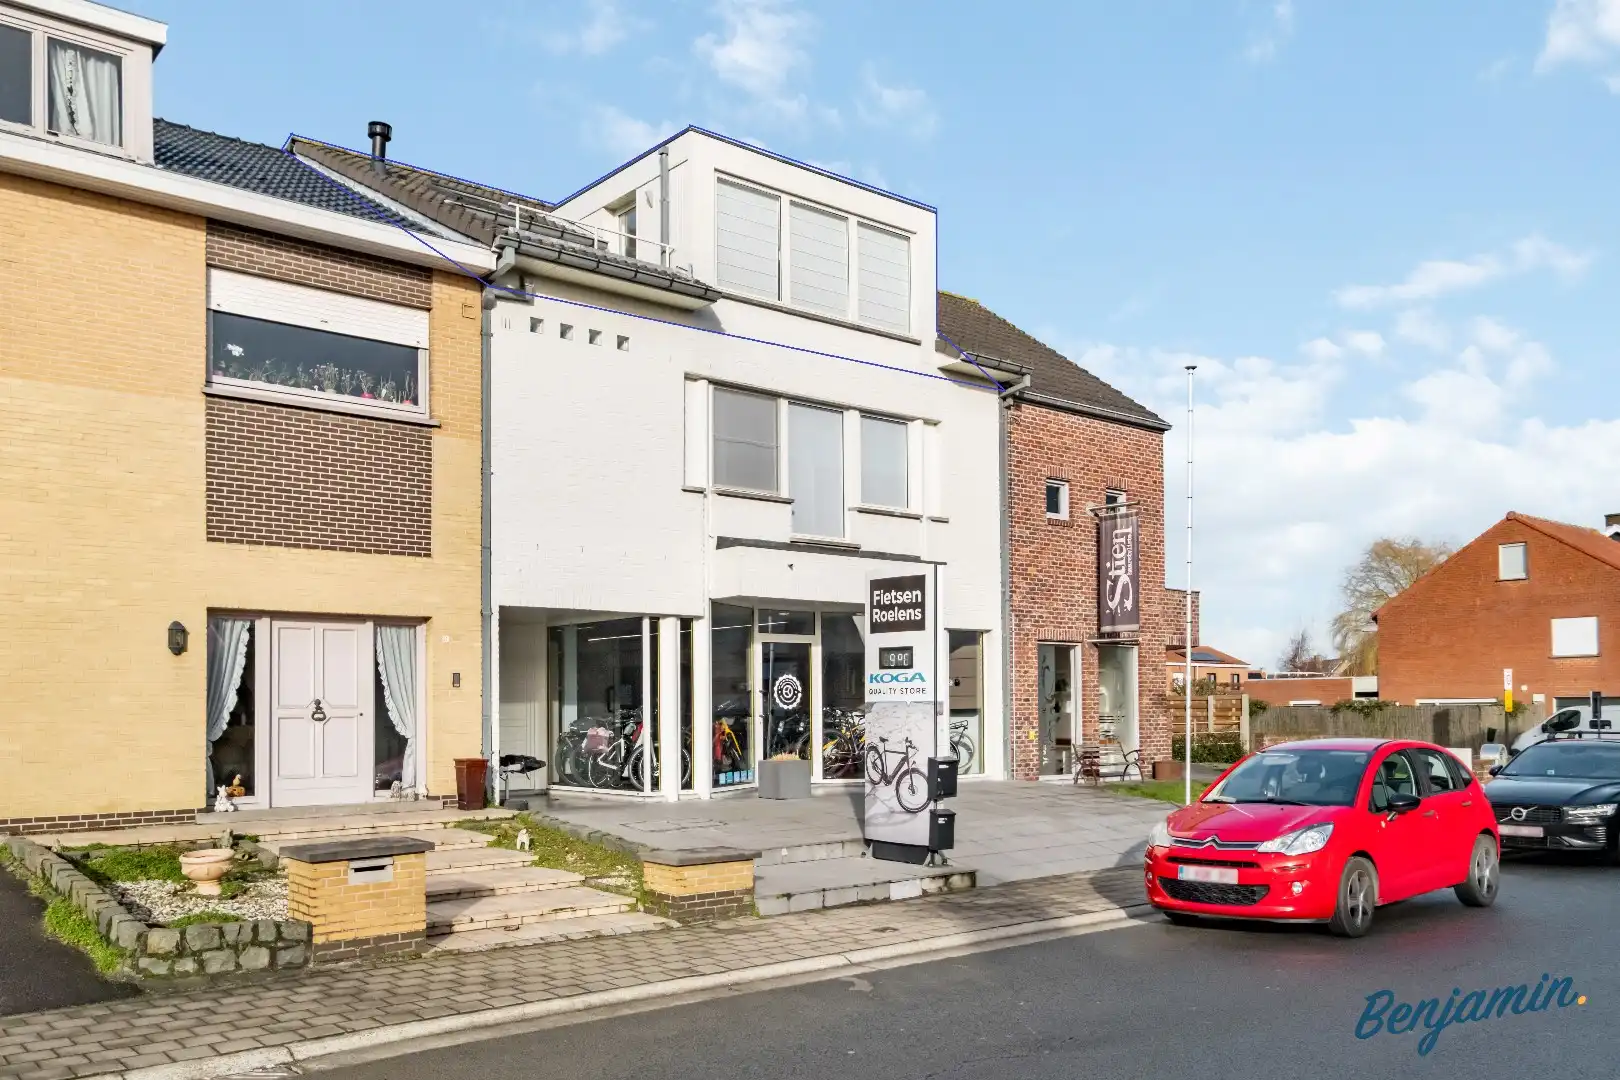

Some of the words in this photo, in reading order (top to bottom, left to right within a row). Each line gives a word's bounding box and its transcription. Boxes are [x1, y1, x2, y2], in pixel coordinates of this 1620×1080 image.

[1105, 525, 1133, 612] Stien
[873, 589, 922, 606] Fietsen
[872, 606, 922, 623] Roelens
[869, 672, 927, 684] KOGA
[868, 687, 897, 695] QUALTY
[900, 687, 927, 695] STORE
